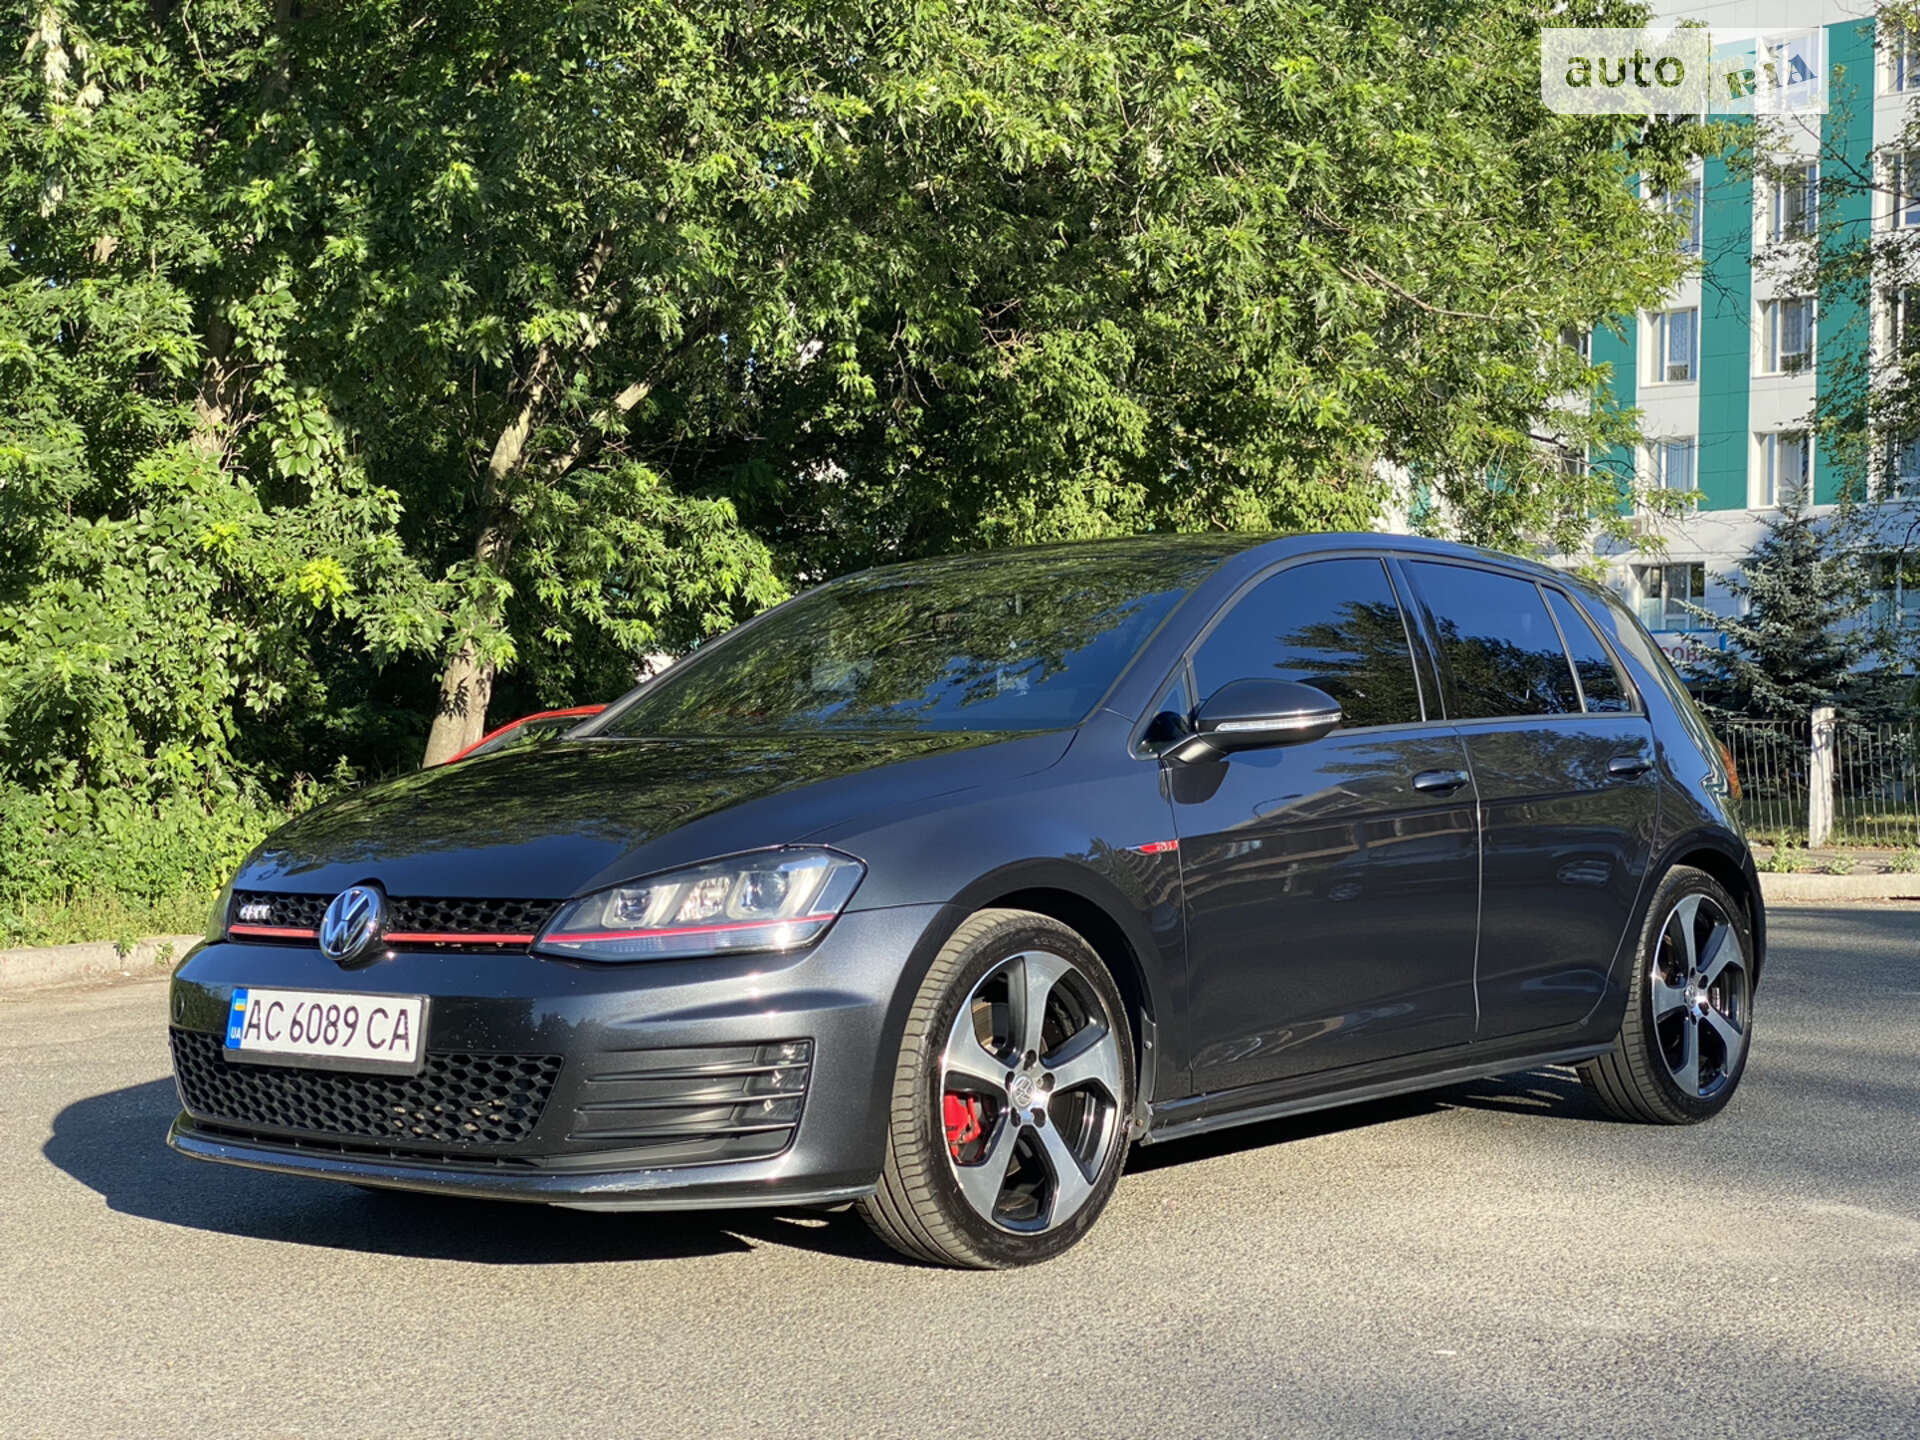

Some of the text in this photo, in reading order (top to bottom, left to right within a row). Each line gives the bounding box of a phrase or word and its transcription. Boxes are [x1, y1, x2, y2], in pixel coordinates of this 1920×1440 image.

[244, 1000, 410, 1052] AC 6089 CA
